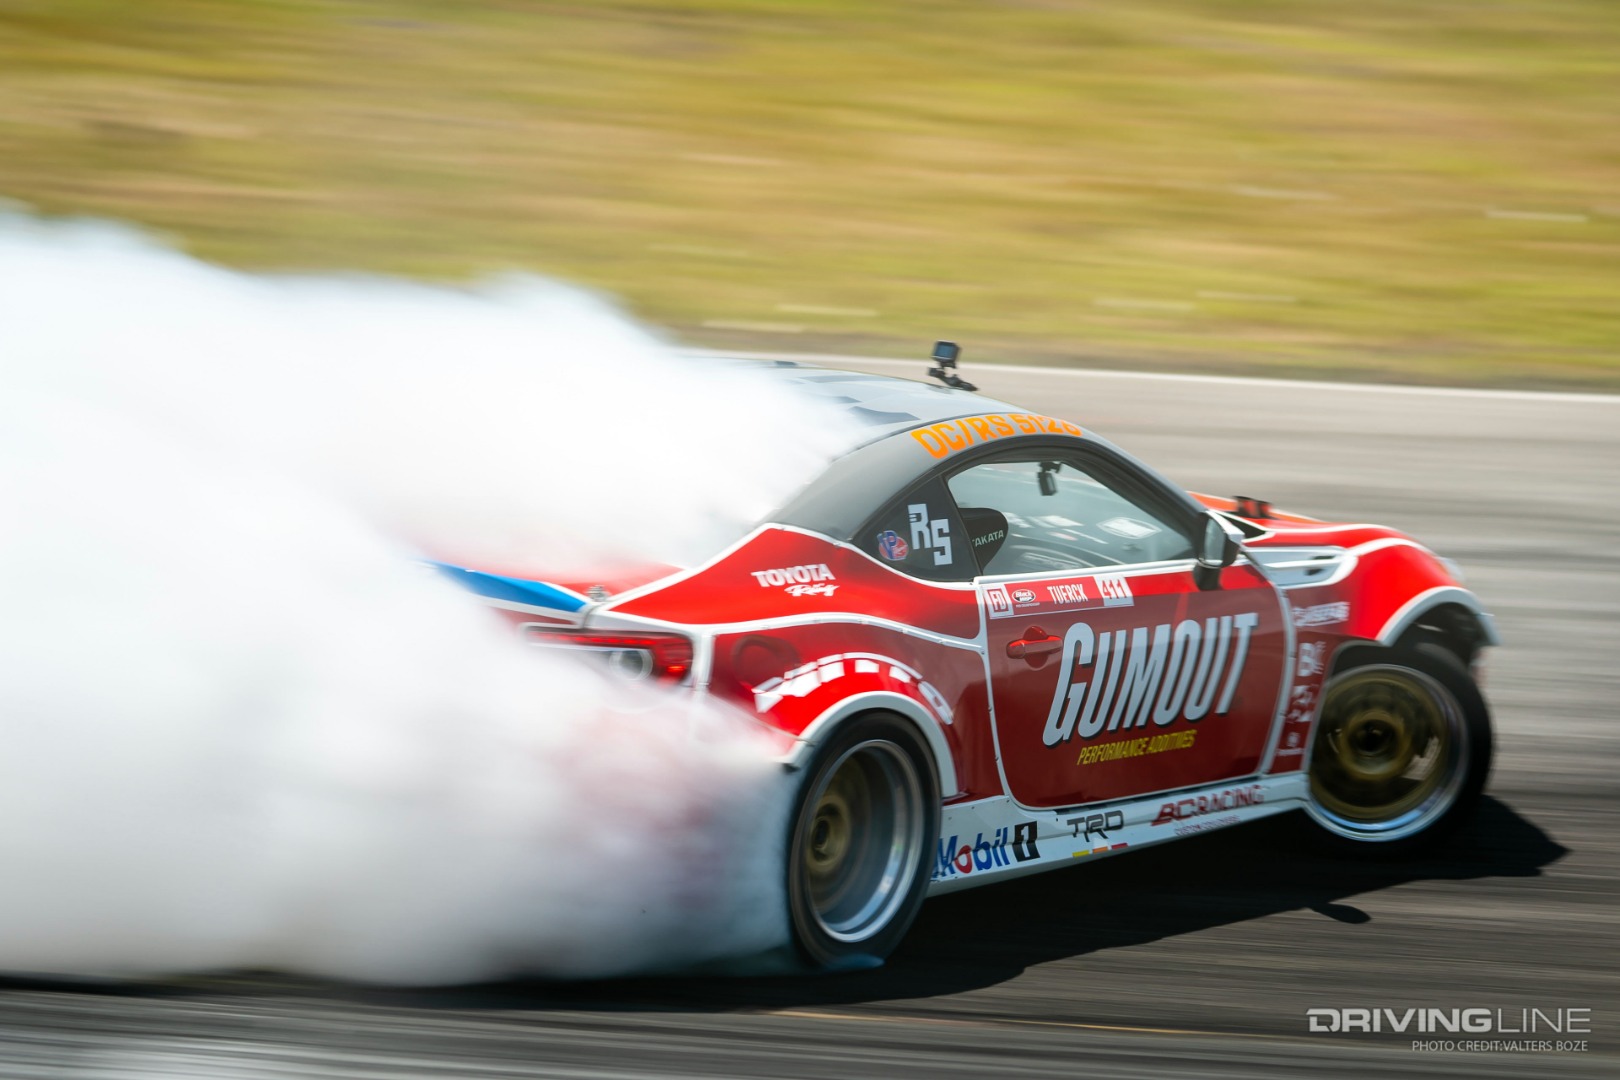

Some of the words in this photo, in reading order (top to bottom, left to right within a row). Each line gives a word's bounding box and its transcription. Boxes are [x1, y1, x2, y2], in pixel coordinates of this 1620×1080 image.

[910, 414, 1015, 459] DC/RS
[972, 530, 1005, 548] AKATA
[750, 563, 836, 588] TOYOTA
[1046, 583, 1089, 604] TUERCK
[1042, 612, 1258, 747] GUMOUT
[1077, 737, 1149, 765] PERFORMANCE
[1066, 810, 1125, 842] TRD
[932, 827, 1010, 879] Mobil
